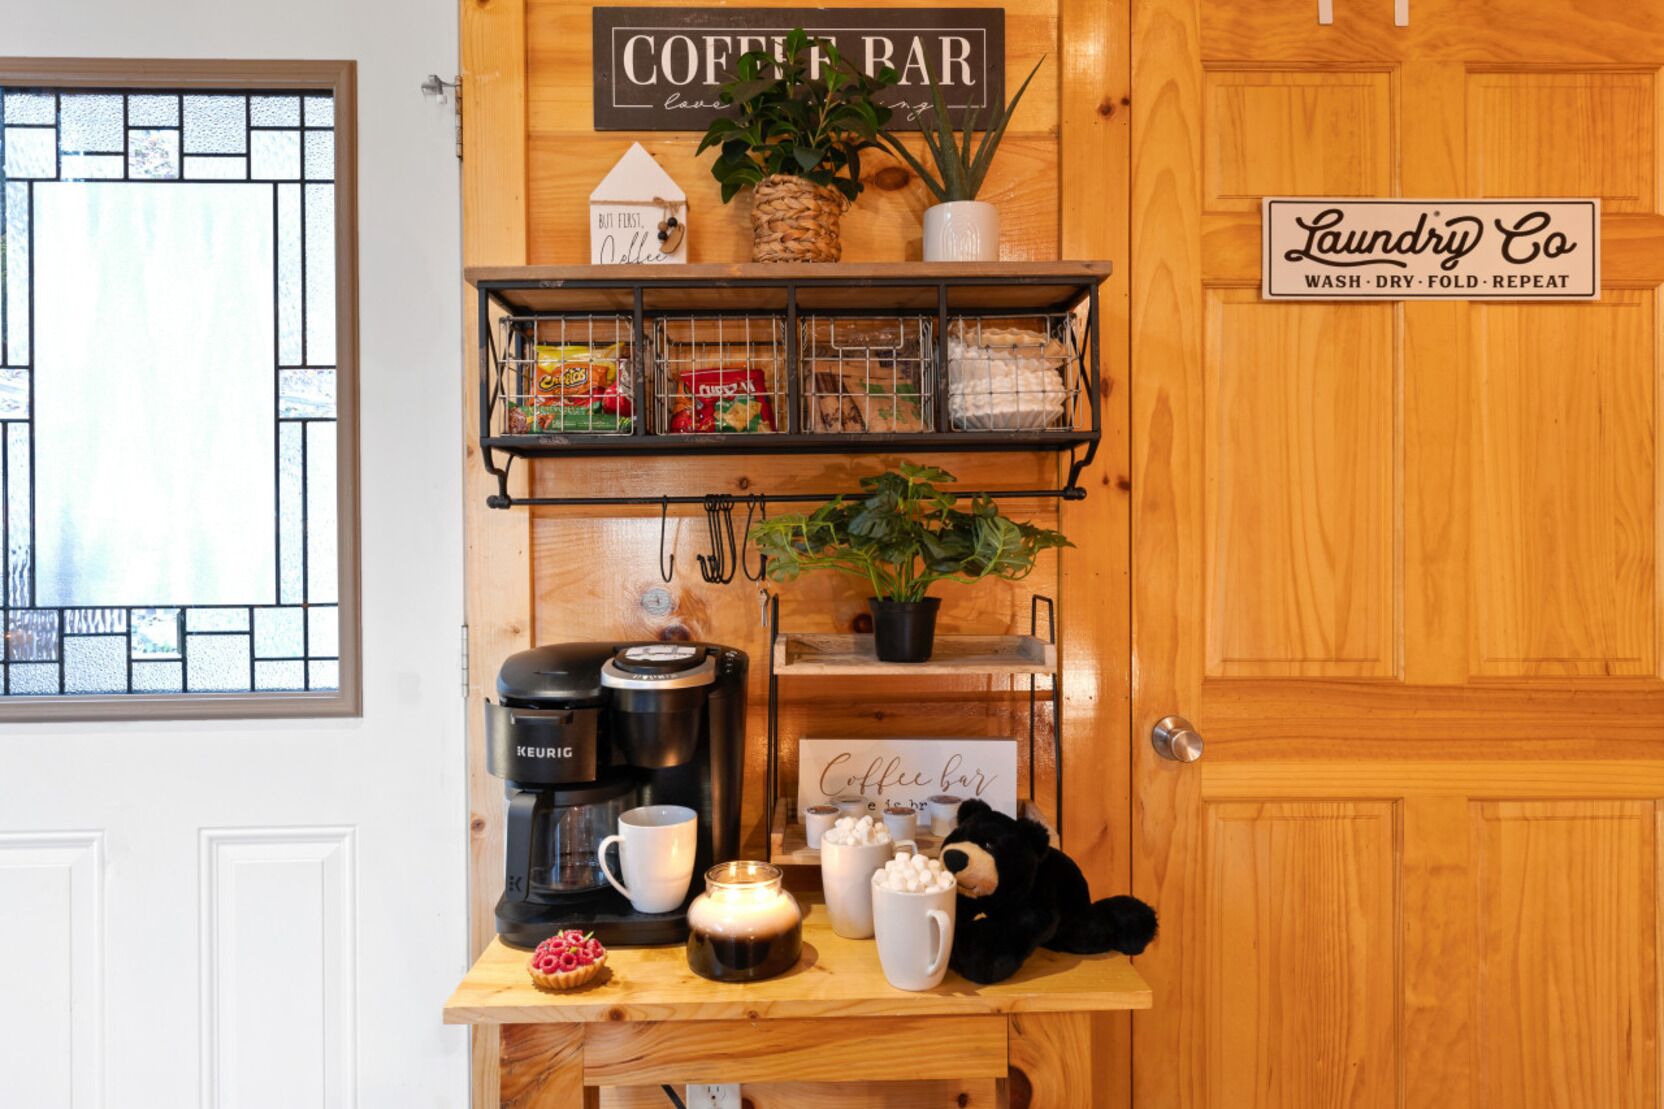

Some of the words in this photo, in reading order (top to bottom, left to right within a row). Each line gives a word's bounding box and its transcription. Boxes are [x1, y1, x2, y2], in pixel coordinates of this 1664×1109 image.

[861, 35, 976, 87] BAR
[598, 212, 614, 229] BUT
[1284, 208, 1485, 271] Laundry
[1494, 211, 1578, 265] Co
[1304, 275, 1362, 289] WASH
[1375, 275, 1415, 289] DRY
[1427, 275, 1479, 289] FOLD
[1492, 275, 1570, 289] REPEAT
[517, 745, 573, 758] KEURIG
[819, 752, 933, 797] Coffee
[939, 753, 999, 797] bar
